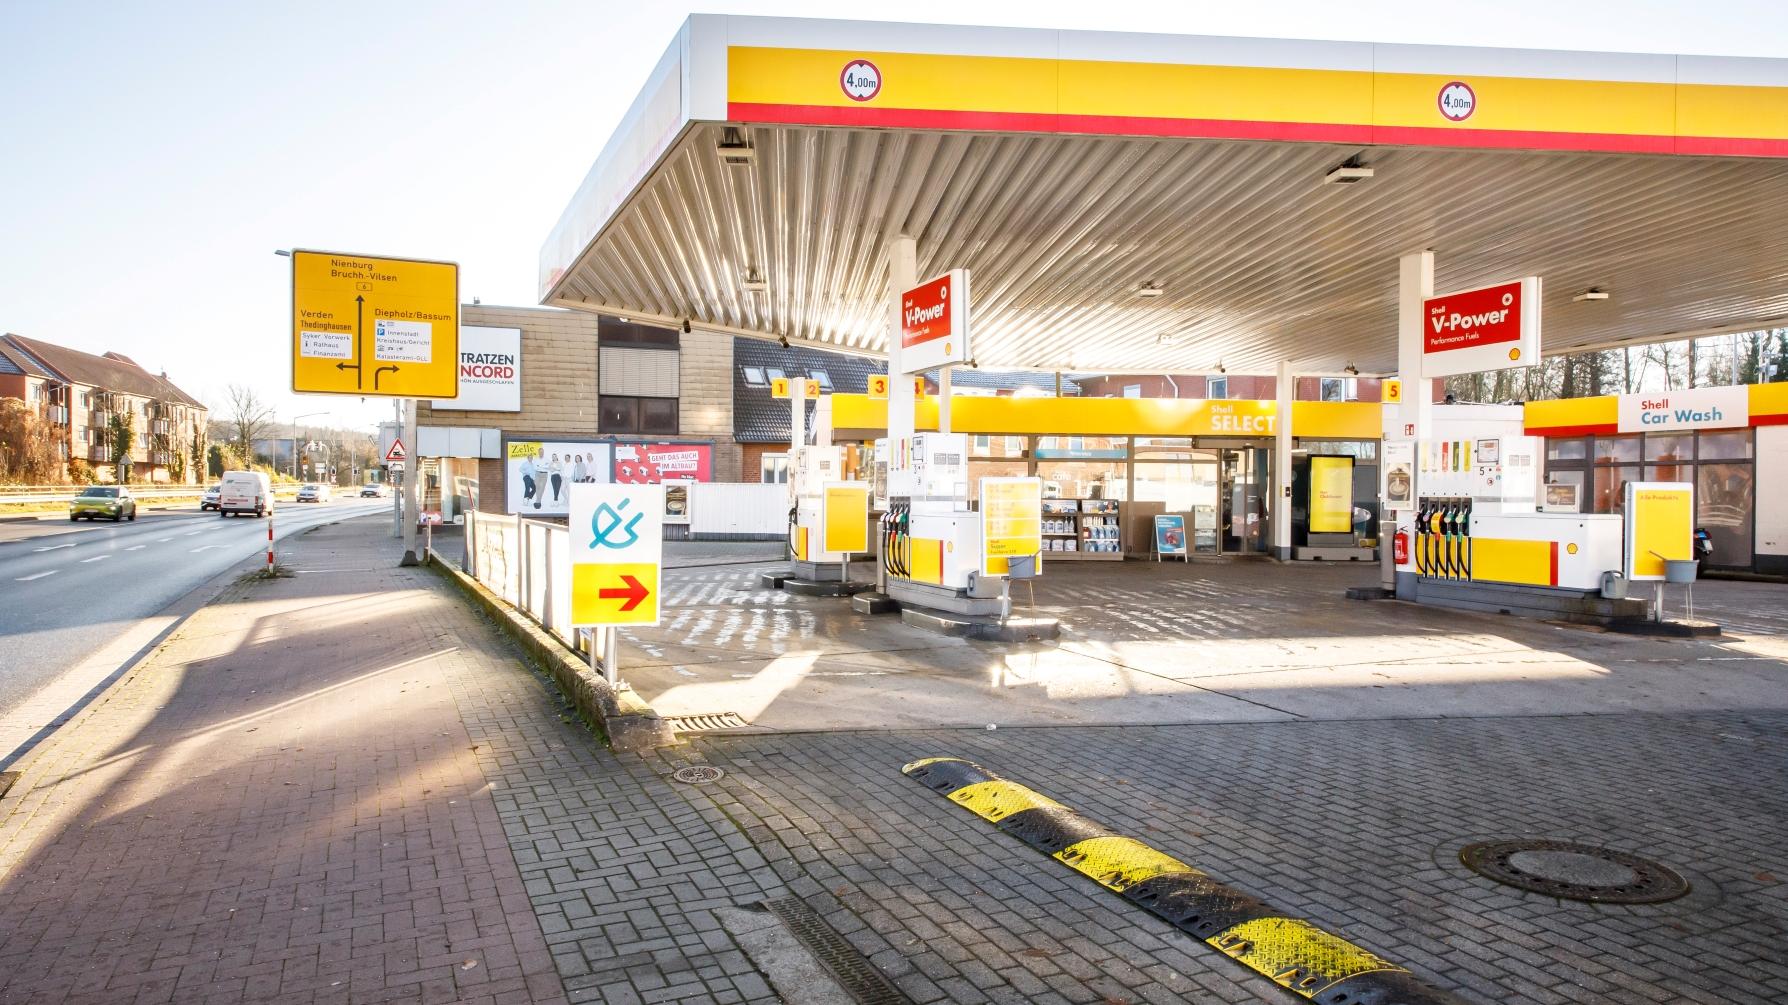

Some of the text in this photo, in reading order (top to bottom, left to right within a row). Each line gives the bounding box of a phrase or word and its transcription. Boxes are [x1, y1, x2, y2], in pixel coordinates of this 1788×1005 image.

[846, 72, 877, 89] 4,00m
[1443, 93, 1471, 109] 4,00m
[331, 259, 373, 271] Nienburg
[331, 269, 398, 282] Bruchh.-Vilsen
[300, 309, 334, 319] Verden
[374, 308, 452, 321] Diepholz/Bassum
[905, 302, 945, 328] V-Power
[1431, 305, 1446, 315] Shell
[300, 320, 352, 331] Thedinghausen
[1431, 308, 1509, 333] V-Power
[302, 332, 321, 340] Syker
[1430, 331, 1480, 346] Performance Fuels
[313, 341, 339, 349] Rathaus
[313, 350, 346, 358] Finanzamt
[460, 364, 514, 379] NCORD
[777, 383, 784, 394] 1
[808, 384, 817, 395] 2
[875, 380, 885, 394] 3
[1390, 385, 1398, 398] 5
[1211, 404, 1233, 414] Shell
[1641, 398, 1669, 410] Shell
[1641, 406, 1723, 425] Car Wash
[1211, 415, 1276, 433] SELECT
[511, 444, 535, 454] Zelle
[681, 452, 697, 460] AUCH
[1479, 466, 1485, 476] 5
